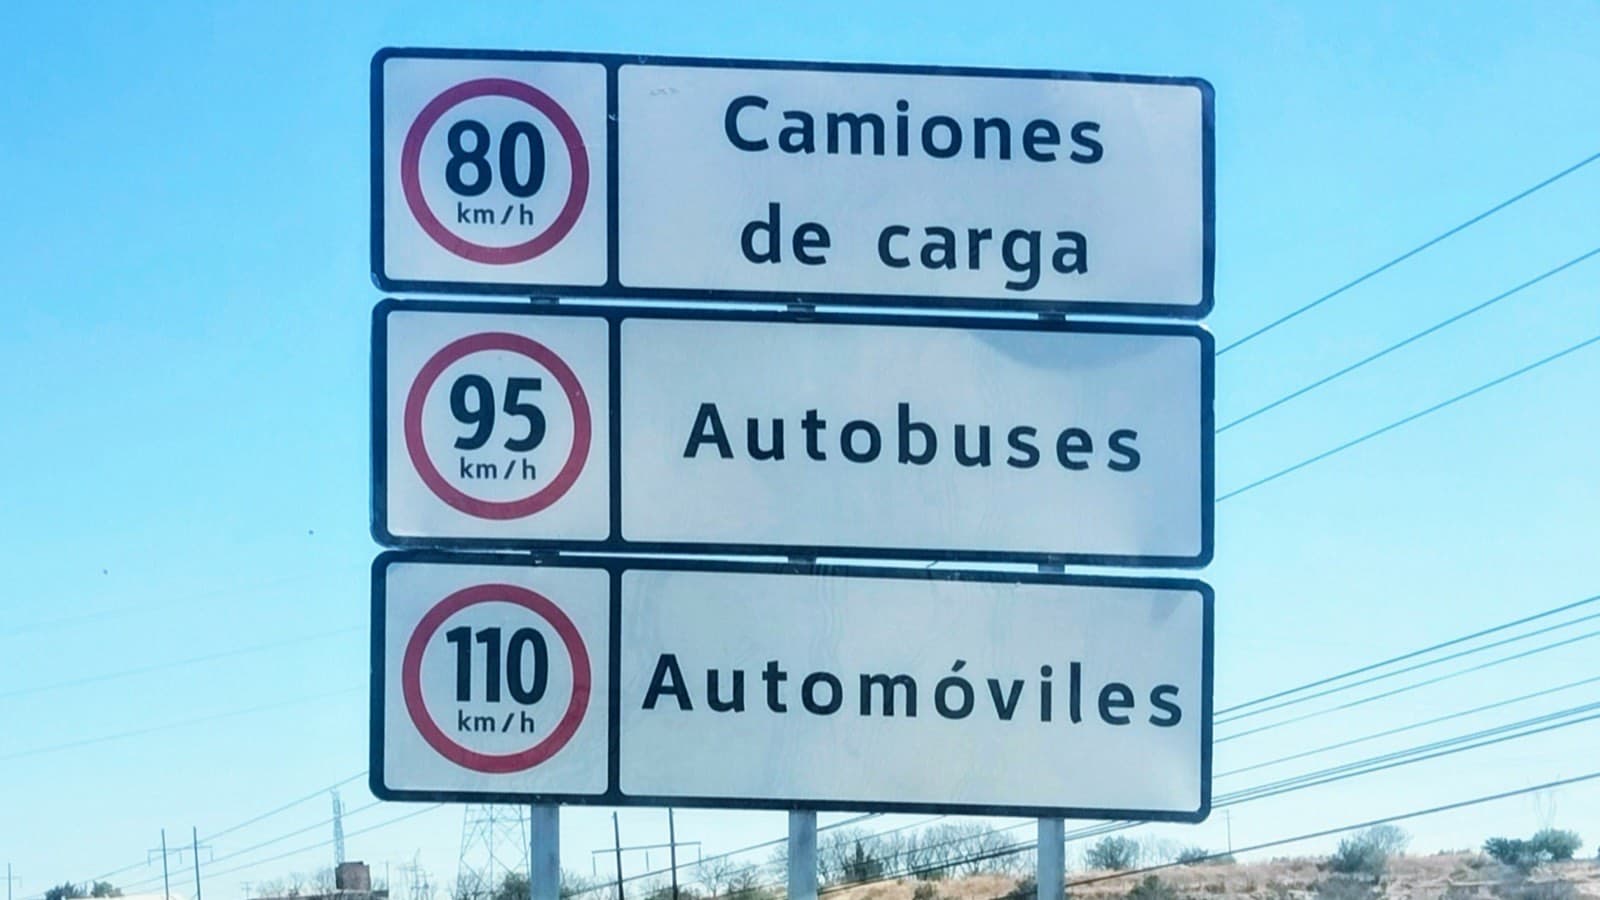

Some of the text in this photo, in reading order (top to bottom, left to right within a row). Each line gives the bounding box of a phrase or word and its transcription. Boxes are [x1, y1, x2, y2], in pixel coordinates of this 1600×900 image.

[445, 119, 546, 198] 80
[724, 95, 1104, 164] Camiones
[457, 202, 534, 226] km/h
[740, 202, 1088, 291] de carga
[449, 373, 546, 453] 95
[683, 402, 1141, 472] Autobuses
[460, 456, 536, 480] km/h
[445, 625, 549, 706] 110
[641, 653, 1182, 727] Automóviles
[457, 709, 535, 734] km/h
